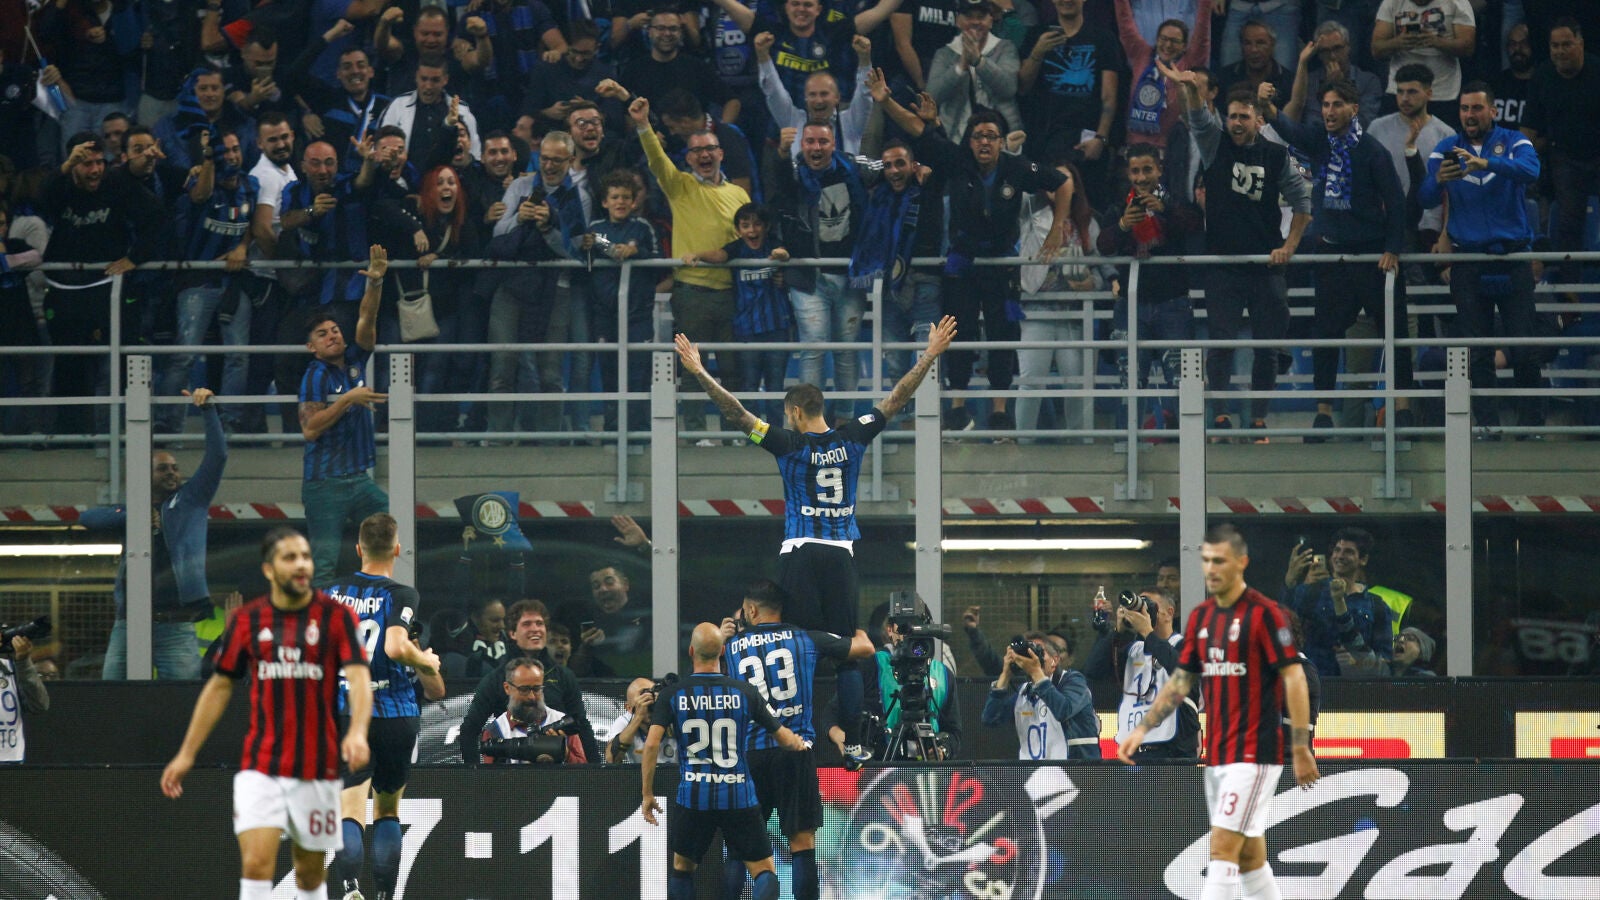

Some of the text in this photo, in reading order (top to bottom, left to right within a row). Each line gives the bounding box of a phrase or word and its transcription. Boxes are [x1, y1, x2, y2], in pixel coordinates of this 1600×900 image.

[919, 6, 958, 26] MILA
[1131, 108, 1158, 121] INTER
[740, 267, 777, 281] PIRE
[811, 446, 848, 465] ICARDI
[816, 467, 843, 504] 9
[738, 648, 798, 701] 33
[0, 691, 18, 726] 9
[682, 718, 739, 768] 20
[1219, 793, 1238, 817] 13
[308, 809, 337, 837] 68
